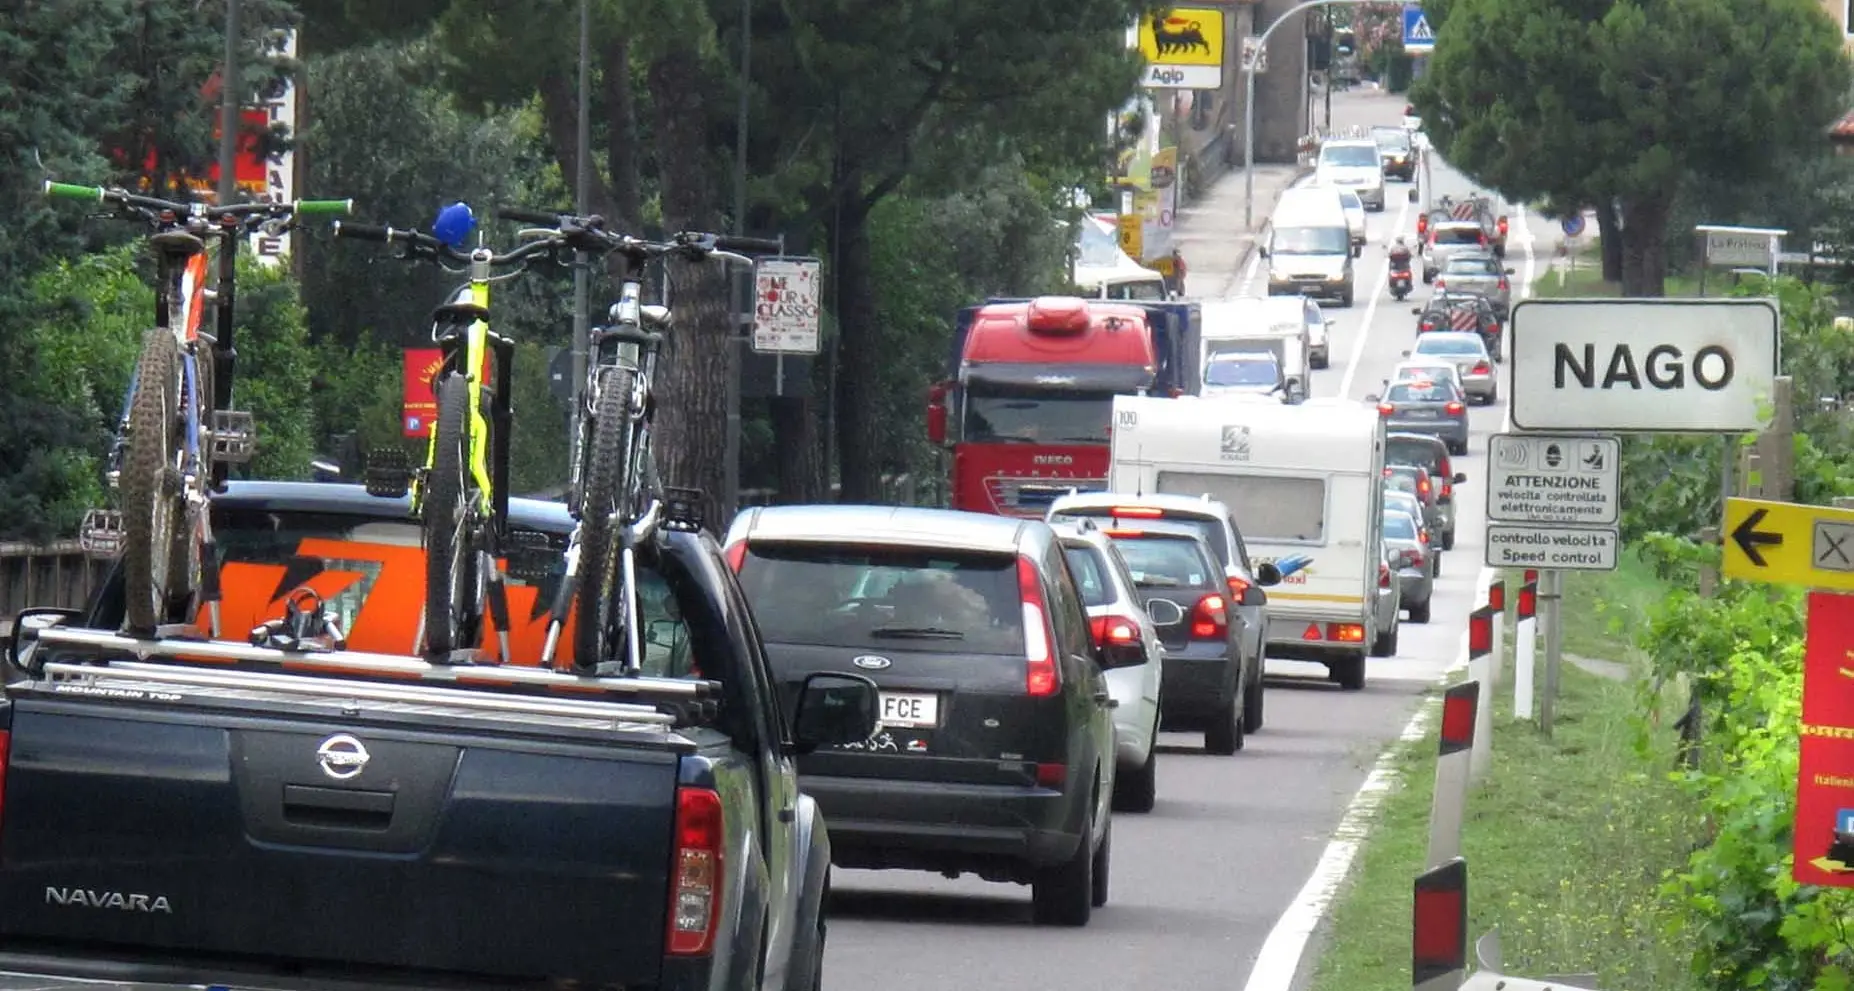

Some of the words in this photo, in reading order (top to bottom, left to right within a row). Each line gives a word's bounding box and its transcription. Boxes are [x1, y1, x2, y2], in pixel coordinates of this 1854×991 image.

[1152, 67, 1185, 84] Agip
[1554, 342, 1735, 391] NAGO
[1119, 411, 1137, 424] 100
[1034, 455, 1073, 465] IVECO
[1505, 475, 1600, 489] ATTENZIONE
[1546, 491, 1607, 502] controllata
[1501, 503, 1603, 514] elettronicamente
[1491, 533, 1550, 545] controllo
[1502, 549, 1546, 562] Speed
[1551, 552, 1602, 564] control
[55, 685, 144, 699] MOUNTAIN
[149, 692, 183, 701] TOP
[885, 697, 922, 719] FCE
[45, 886, 173, 914] NAVARA
